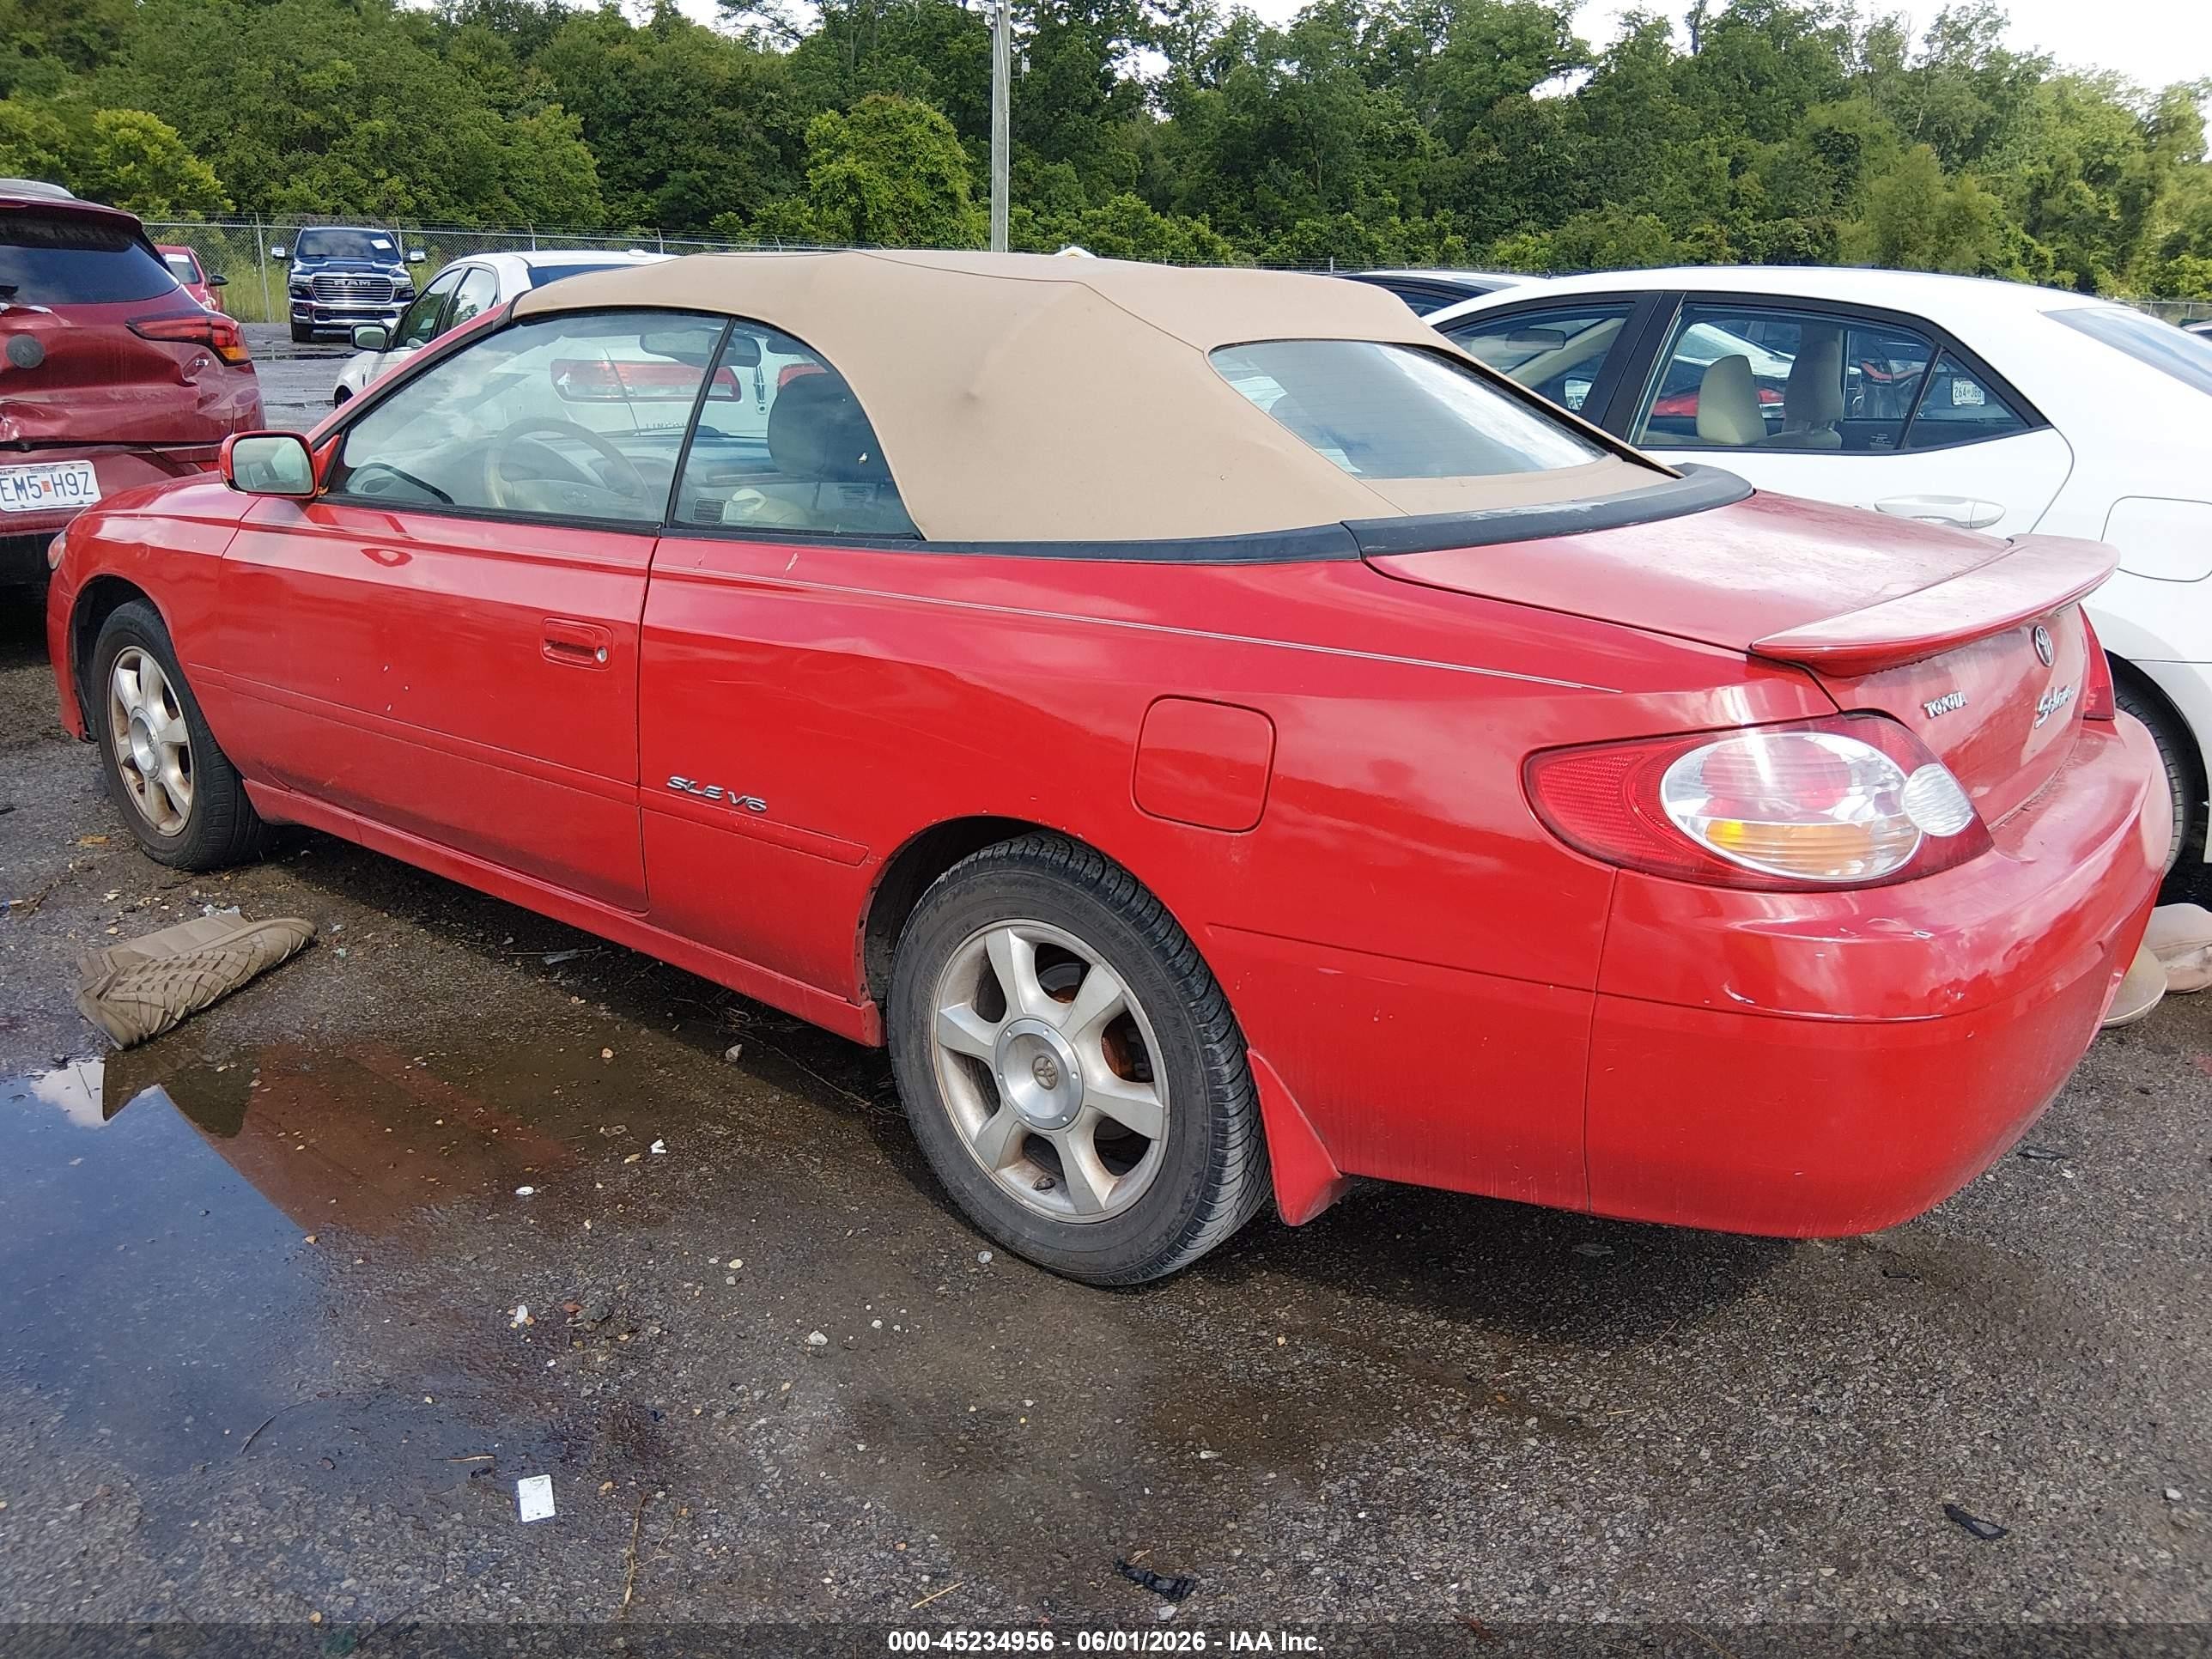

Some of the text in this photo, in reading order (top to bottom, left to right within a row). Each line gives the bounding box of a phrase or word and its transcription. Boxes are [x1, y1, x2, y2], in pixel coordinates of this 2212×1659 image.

[1954, 386, 1966, 398] 264
[0, 471, 94, 501] EM5 H9Z
[1923, 690, 1968, 719] TOYOTA
[666, 775, 768, 811] SLE V6
